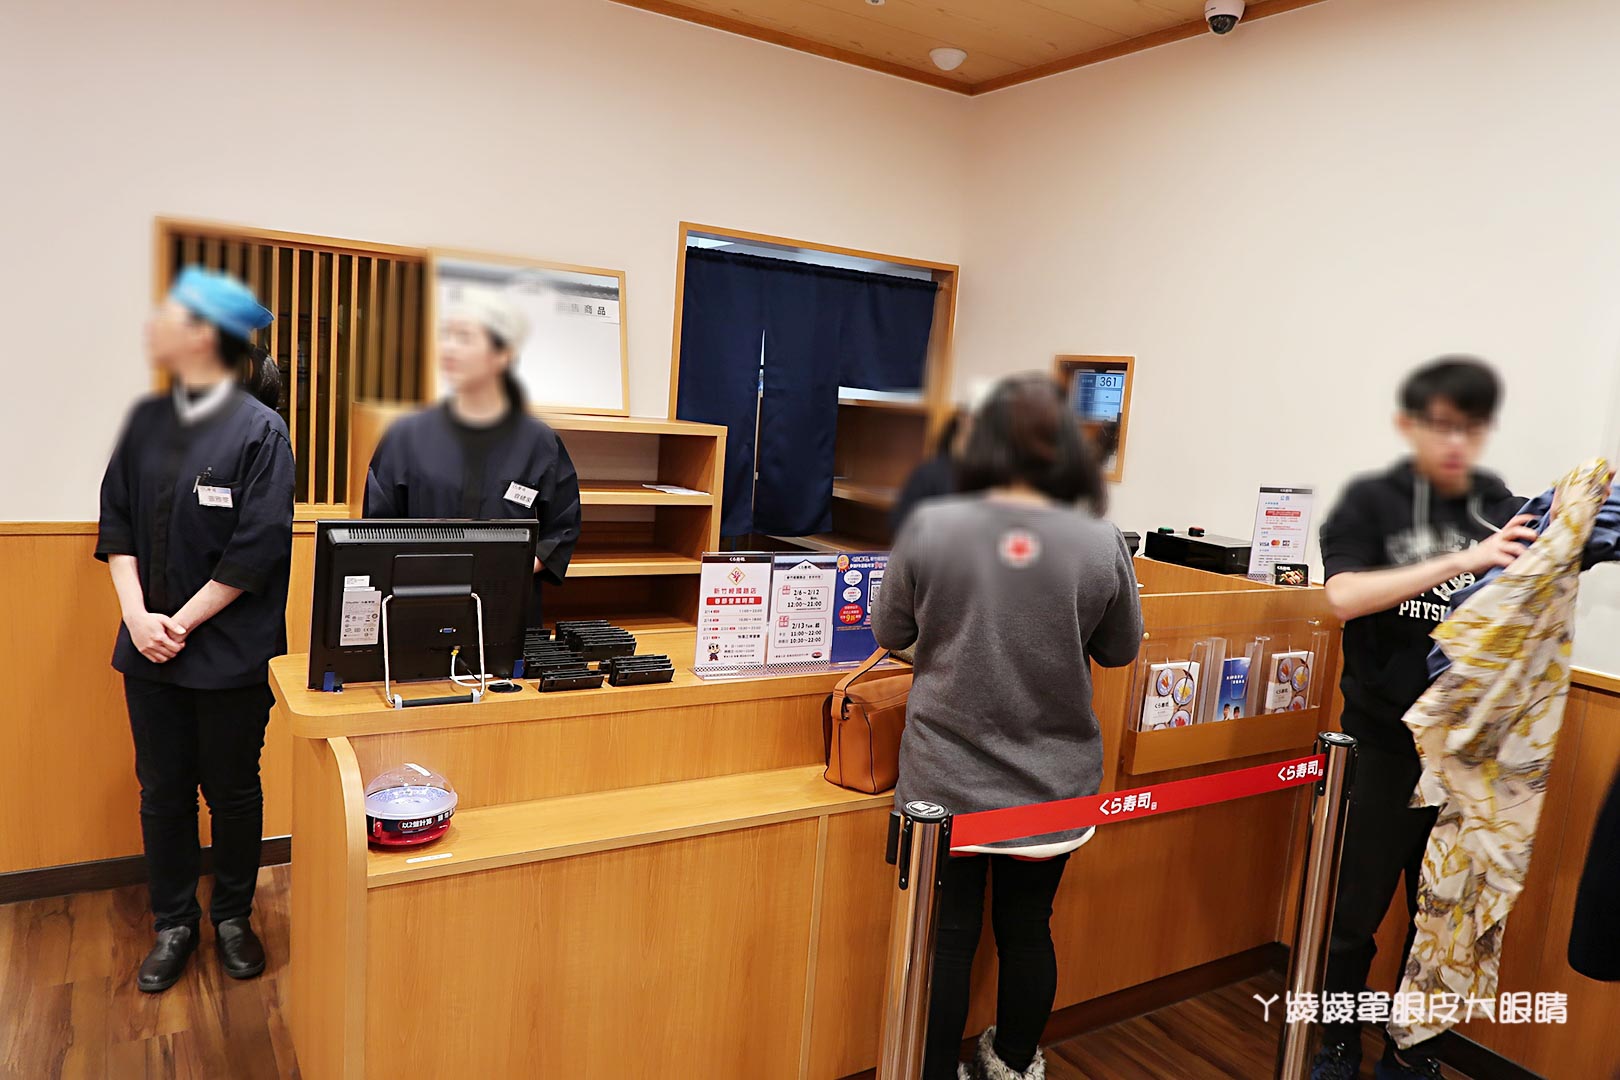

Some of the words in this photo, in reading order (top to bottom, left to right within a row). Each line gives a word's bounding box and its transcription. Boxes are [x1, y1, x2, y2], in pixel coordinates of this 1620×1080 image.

[1099, 376, 1117, 387] 361
[1398, 599, 1446, 623] PHYSI
[792, 622, 805, 630] 2/13
[1277, 759, 1319, 781] くら寿司
[1099, 791, 1152, 816] くら寿司
